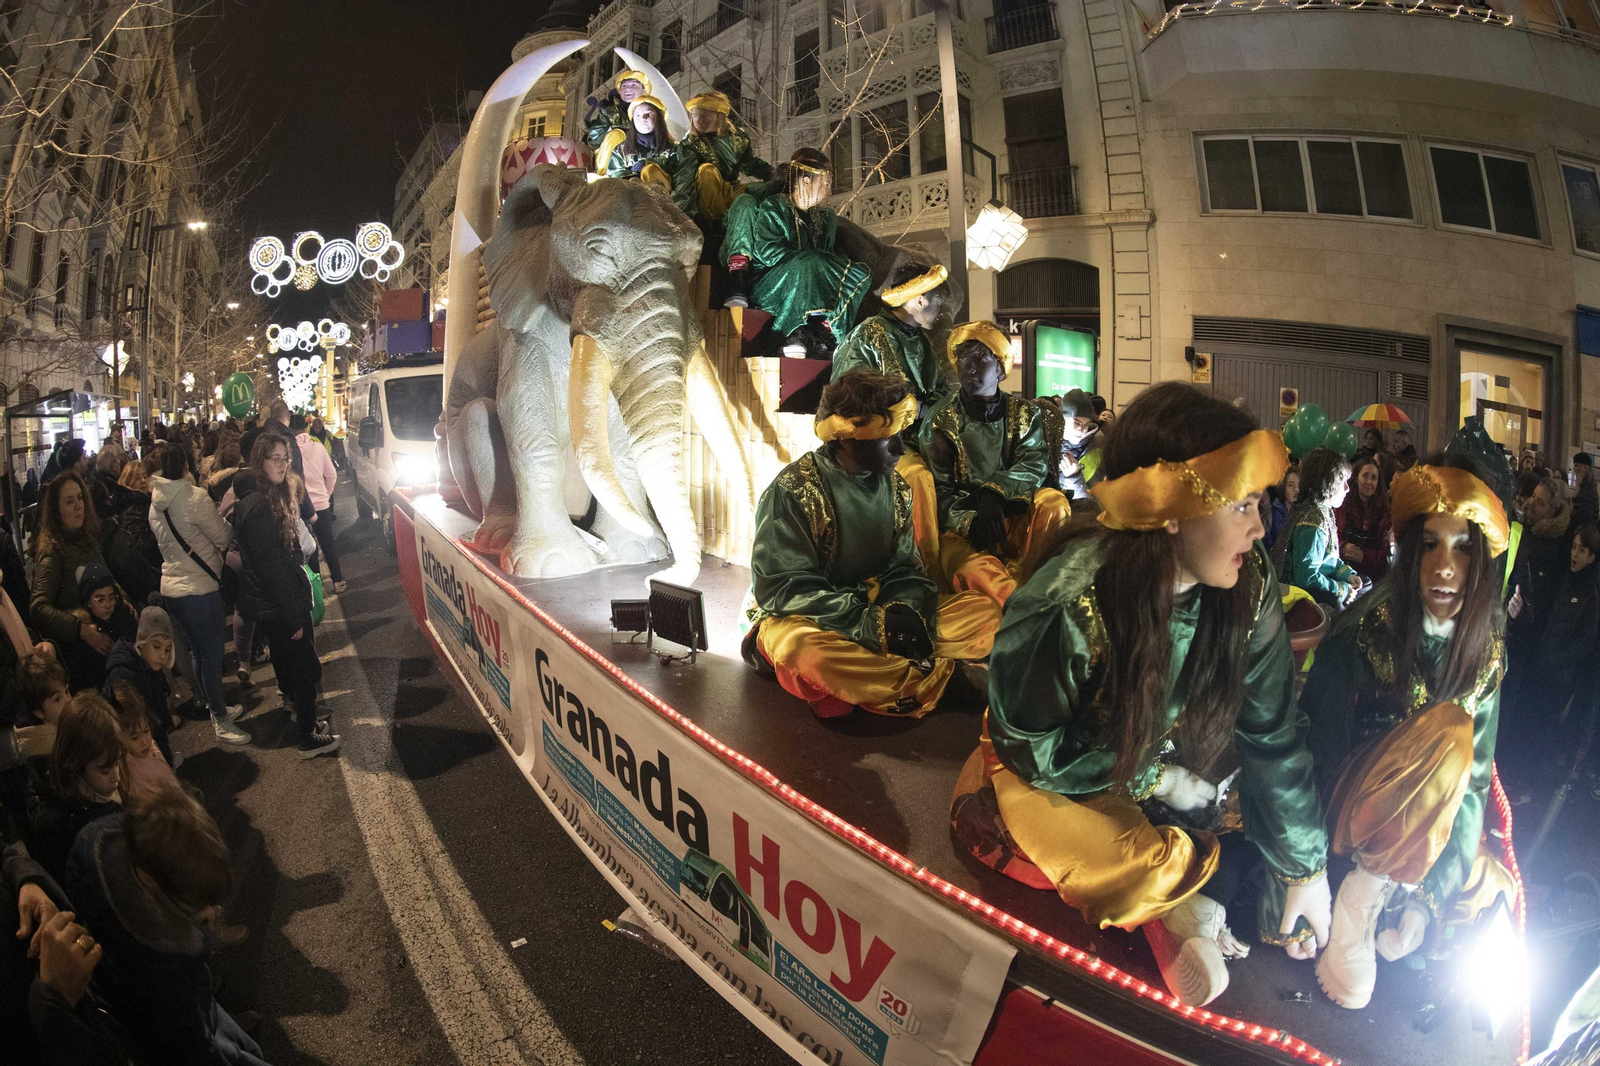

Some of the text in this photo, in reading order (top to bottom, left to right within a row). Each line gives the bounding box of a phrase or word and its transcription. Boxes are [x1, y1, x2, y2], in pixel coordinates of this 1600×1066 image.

[421, 535, 467, 616] Granada
[465, 580, 502, 669] Hoy
[535, 648, 897, 1002] Granada Hoy
[603, 792, 625, 816] estreno
[624, 812, 634, 826] del
[633, 820, 653, 844] Metro
[652, 841, 675, 866] rompe
[606, 814, 659, 869] infraestructuras
[542, 774, 558, 803] La
[559, 798, 634, 889] Alhambra
[638, 887, 698, 950] acaba
[702, 951, 747, 994] con
[754, 985, 793, 1032] las
[603, 831, 639, 867] MONUMENTO
[639, 865, 654, 882] PARA
[686, 912, 695, 924] EL
[696, 921, 735, 958] SERVICIO
[780, 949, 875, 1036] El Año Lorca pone
[780, 962, 879, 1050] en marcha la carrera
[780, 971, 796, 987] por
[797, 984, 807, 997] la
[808, 994, 861, 1044] Capitalidad
[880, 990, 908, 1017] 20
